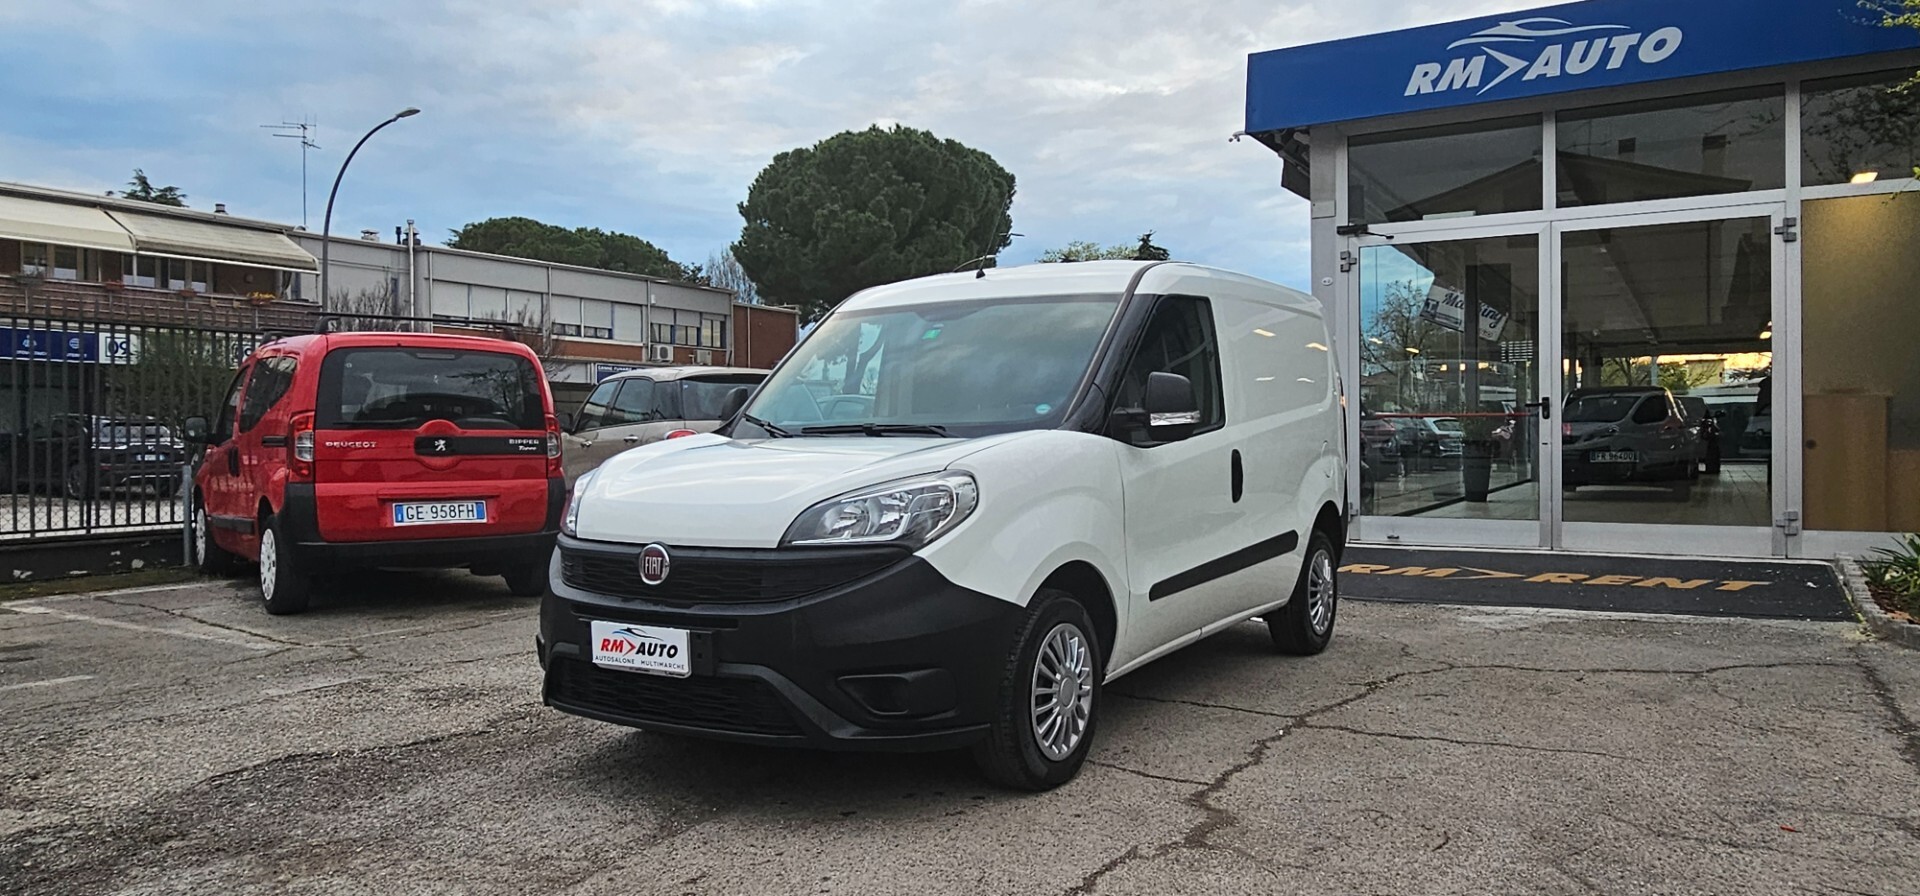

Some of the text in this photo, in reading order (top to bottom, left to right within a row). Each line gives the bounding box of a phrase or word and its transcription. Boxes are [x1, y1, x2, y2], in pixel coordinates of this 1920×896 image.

[1404, 26, 1684, 97] RM AUTO
[405, 504, 475, 520] GE 958FH
[644, 556, 663, 575] FIAT
[1337, 563, 1773, 592] RM RENT
[600, 638, 679, 659] RM AUTO
[594, 655, 635, 665] AUTOSALONE
[640, 660, 686, 671] MULTIMARCHE
